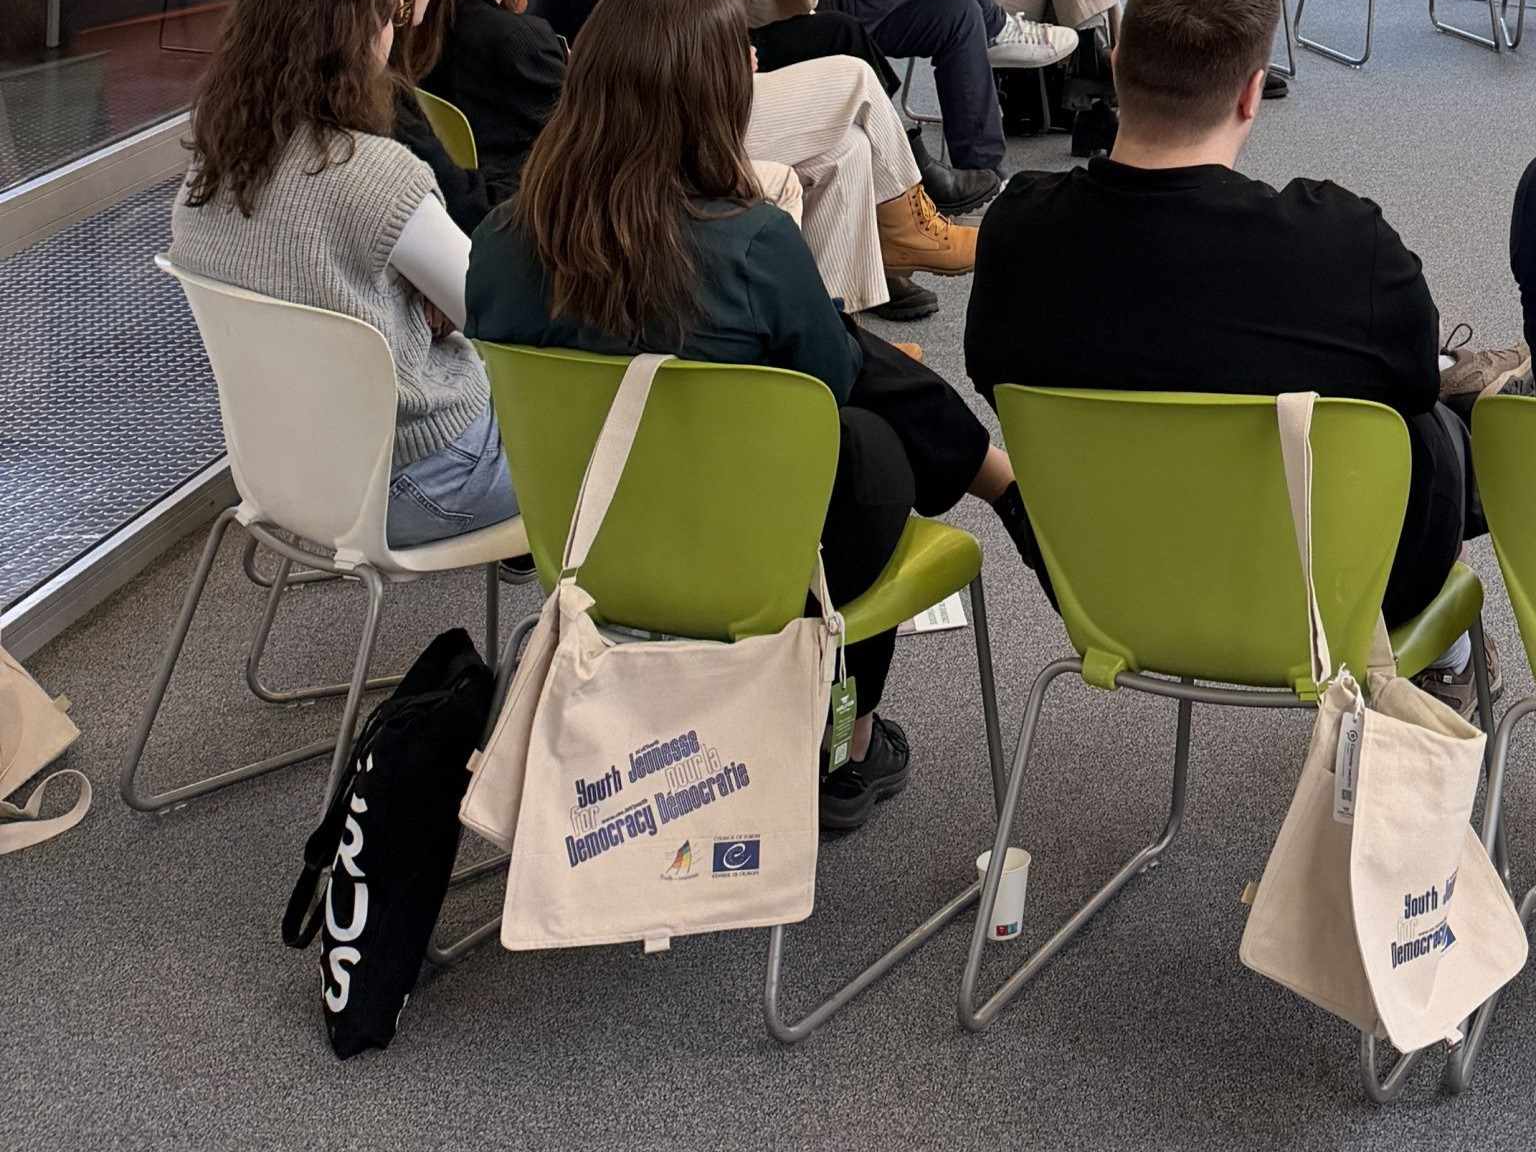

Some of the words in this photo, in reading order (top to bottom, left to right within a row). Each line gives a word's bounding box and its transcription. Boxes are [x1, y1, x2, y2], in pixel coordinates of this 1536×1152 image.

[575, 764, 623, 809] Youth
[628, 729, 701, 784] Jeunesse
[564, 802, 658, 868] Democracy
[654, 761, 751, 825] Démocratie
[1404, 885, 1438, 919] Youth
